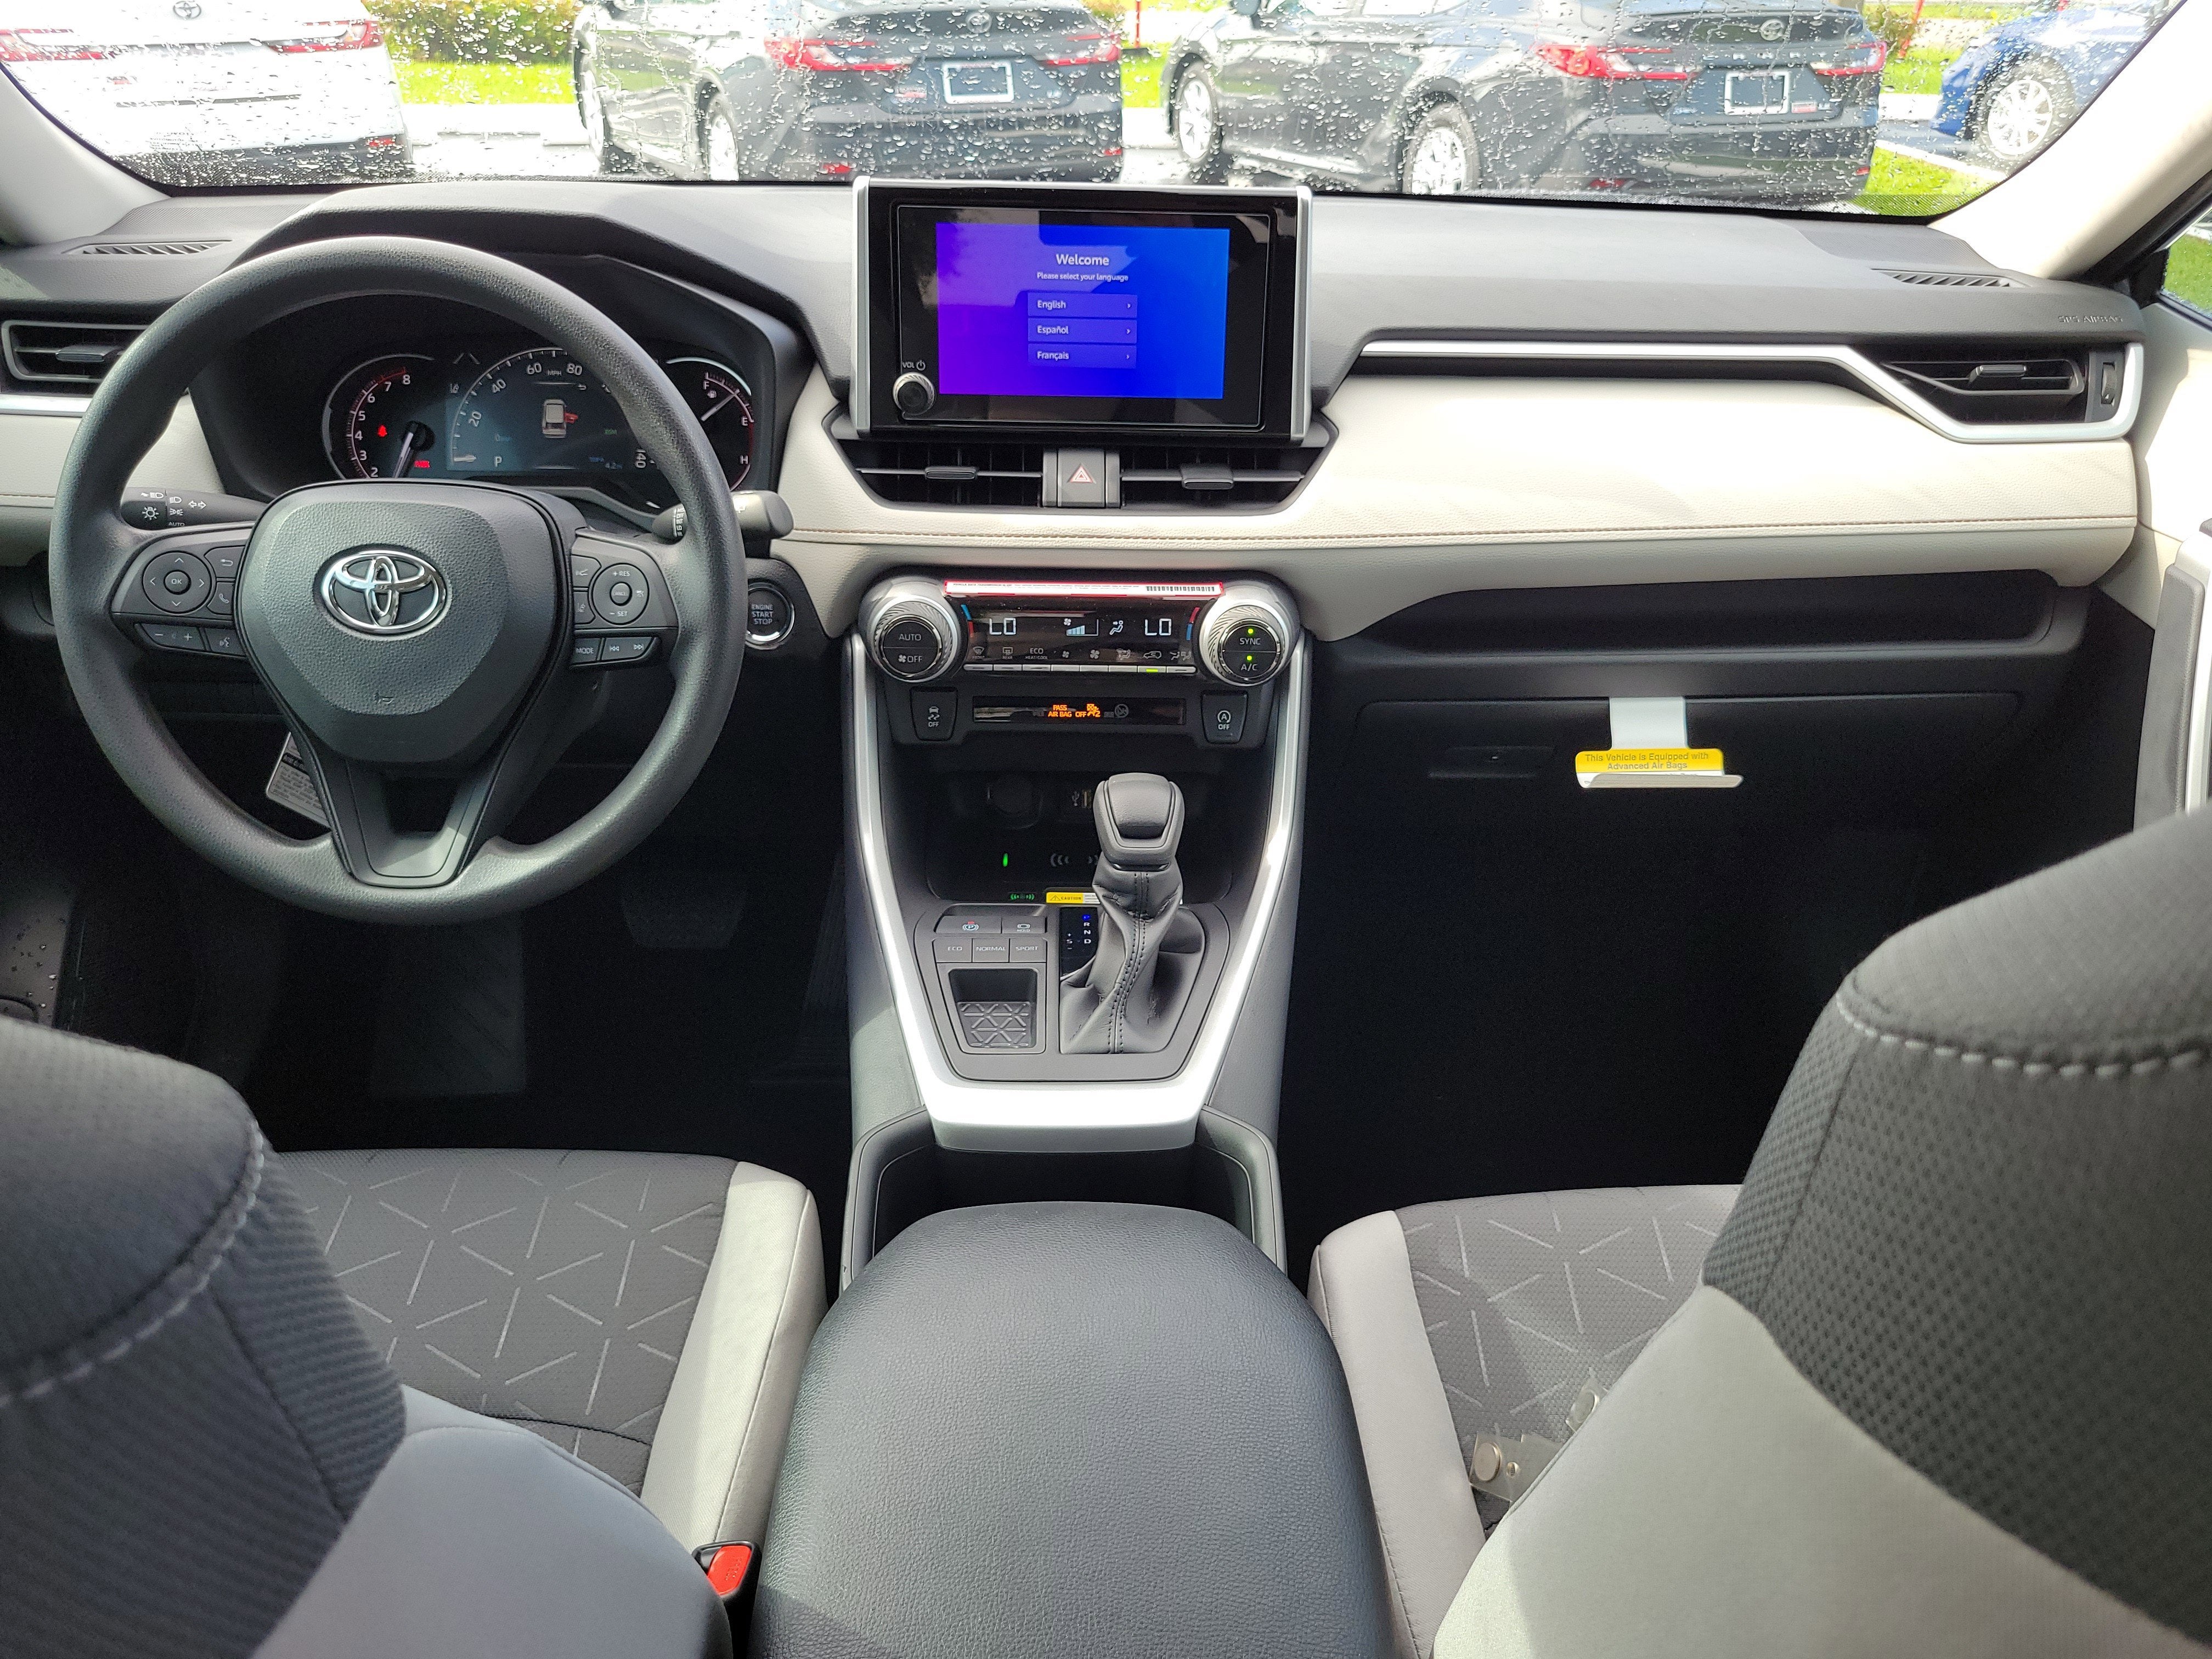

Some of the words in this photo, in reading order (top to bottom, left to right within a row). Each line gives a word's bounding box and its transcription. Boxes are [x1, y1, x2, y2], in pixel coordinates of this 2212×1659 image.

[1056, 253, 1110, 266] Welcome
[1080, 273, 1095, 281] your
[1097, 273, 1128, 283] language
[1037, 300, 1066, 311] English
[1037, 325, 1069, 336] Español
[1037, 351, 1070, 362] Français
[527, 362, 542, 375] 60
[567, 363, 583, 376] 80
[402, 374, 410, 385] 8
[703, 380, 710, 390] F
[385, 381, 392, 392] 7
[492, 379, 506, 393] 40
[367, 393, 375, 403] 6
[358, 411, 366, 421] 5
[469, 411, 482, 427] 20
[741, 416, 748, 426] E
[354, 430, 363, 441] 4
[360, 450, 367, 461] 3
[635, 448, 647, 469] 140
[740, 455, 748, 465] H
[495, 456, 503, 467] P
[370, 466, 379, 477] 2
[1239, 637, 1261, 646] SYNC
[1240, 664, 1258, 672] A/C
[1585, 753, 1604, 761] This
[1606, 752, 1637, 761] Vehicle
[1639, 752, 1646, 760] is
[1649, 752, 1689, 763] Equipped
[1691, 751, 1709, 760] with
[1607, 761, 1649, 770] Advanced
[1651, 761, 1663, 769] Air
[1667, 760, 1688, 770] Bags
